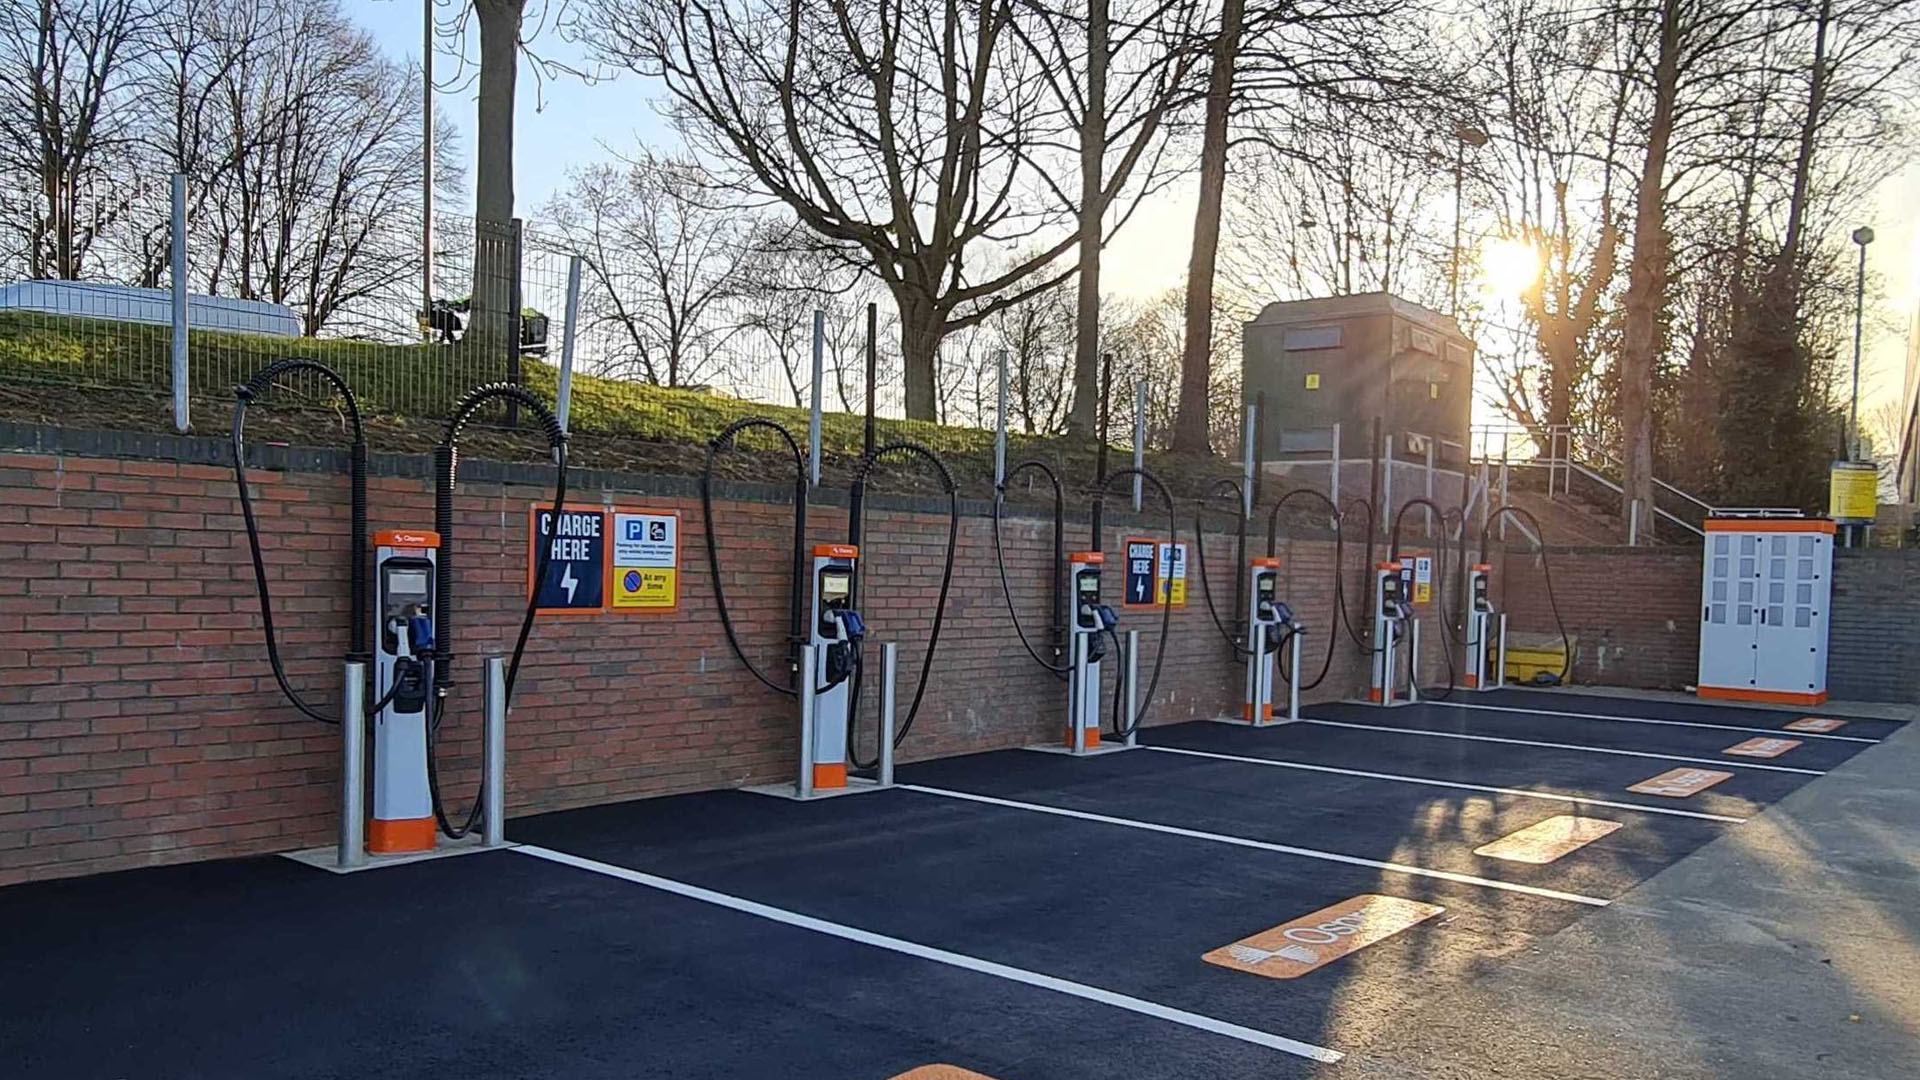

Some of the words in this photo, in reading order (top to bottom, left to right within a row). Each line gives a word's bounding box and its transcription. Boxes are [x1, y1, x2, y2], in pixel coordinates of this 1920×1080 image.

[551, 539, 590, 560] HERE
[1129, 544, 1154, 558] CHARGE
[1132, 560, 1150, 574] HERE
[643, 573, 652, 581] At
[647, 582, 663, 590] time
